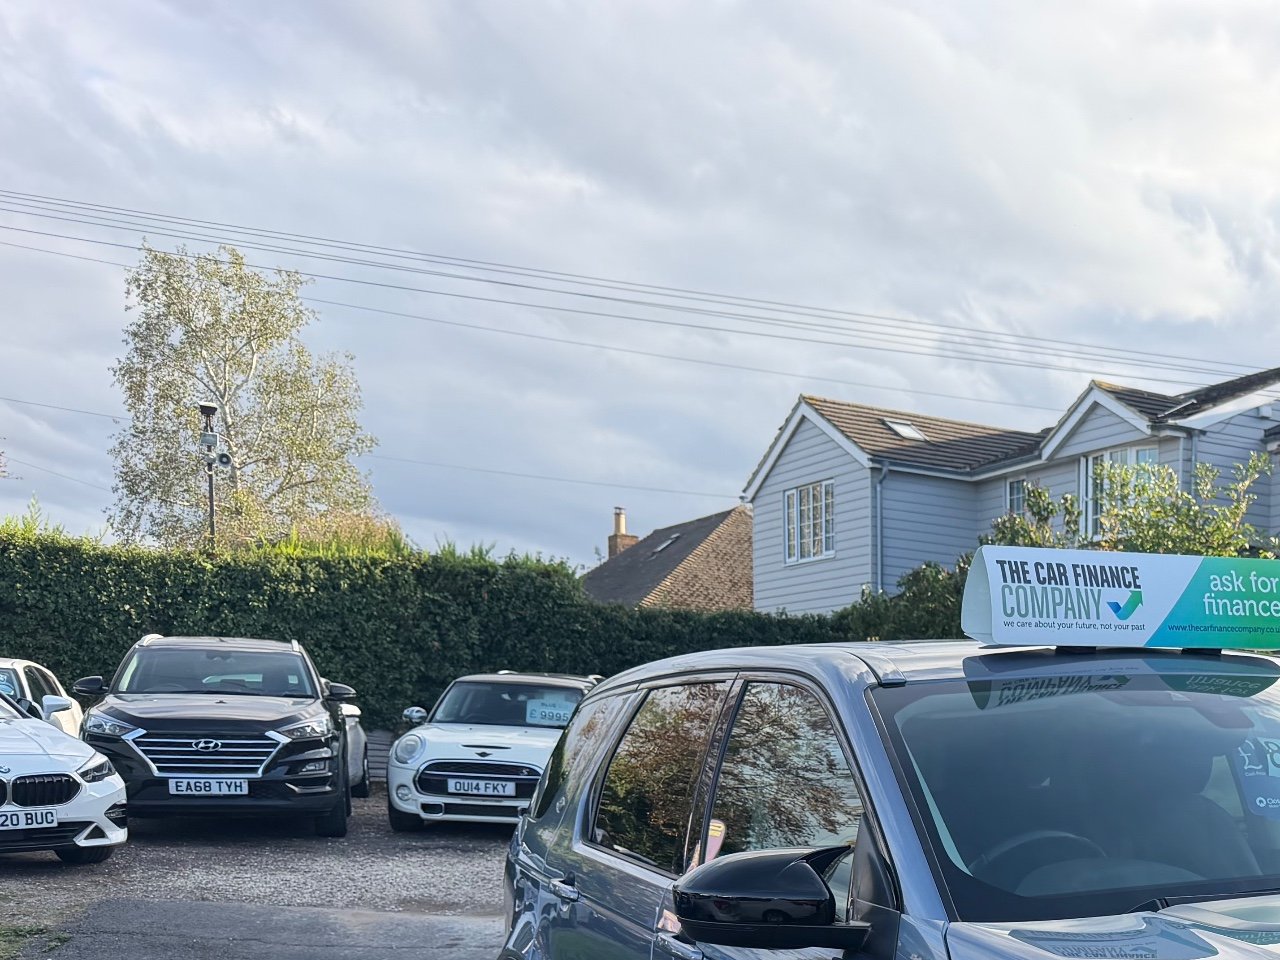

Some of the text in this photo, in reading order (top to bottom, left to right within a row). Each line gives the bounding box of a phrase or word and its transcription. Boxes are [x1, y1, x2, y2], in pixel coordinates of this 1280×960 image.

[996, 560, 1142, 590] THE CAR FINANCE
[1209, 570, 1280, 594] ask for
[1001, 584, 1102, 620] COMPANY
[1003, 620, 1015, 628] we
[1016, 620, 1033, 628] care
[1034, 620, 1056, 629] about
[1057, 622, 1074, 631] your
[1100, 621, 1113, 630] not
[1113, 622, 1130, 632] your
[1131, 623, 1146, 632] past
[174, 780, 243, 793] EA68 TYH
[454, 781, 508, 793] OU14 FKY
[24, 811, 55, 826] BUC
